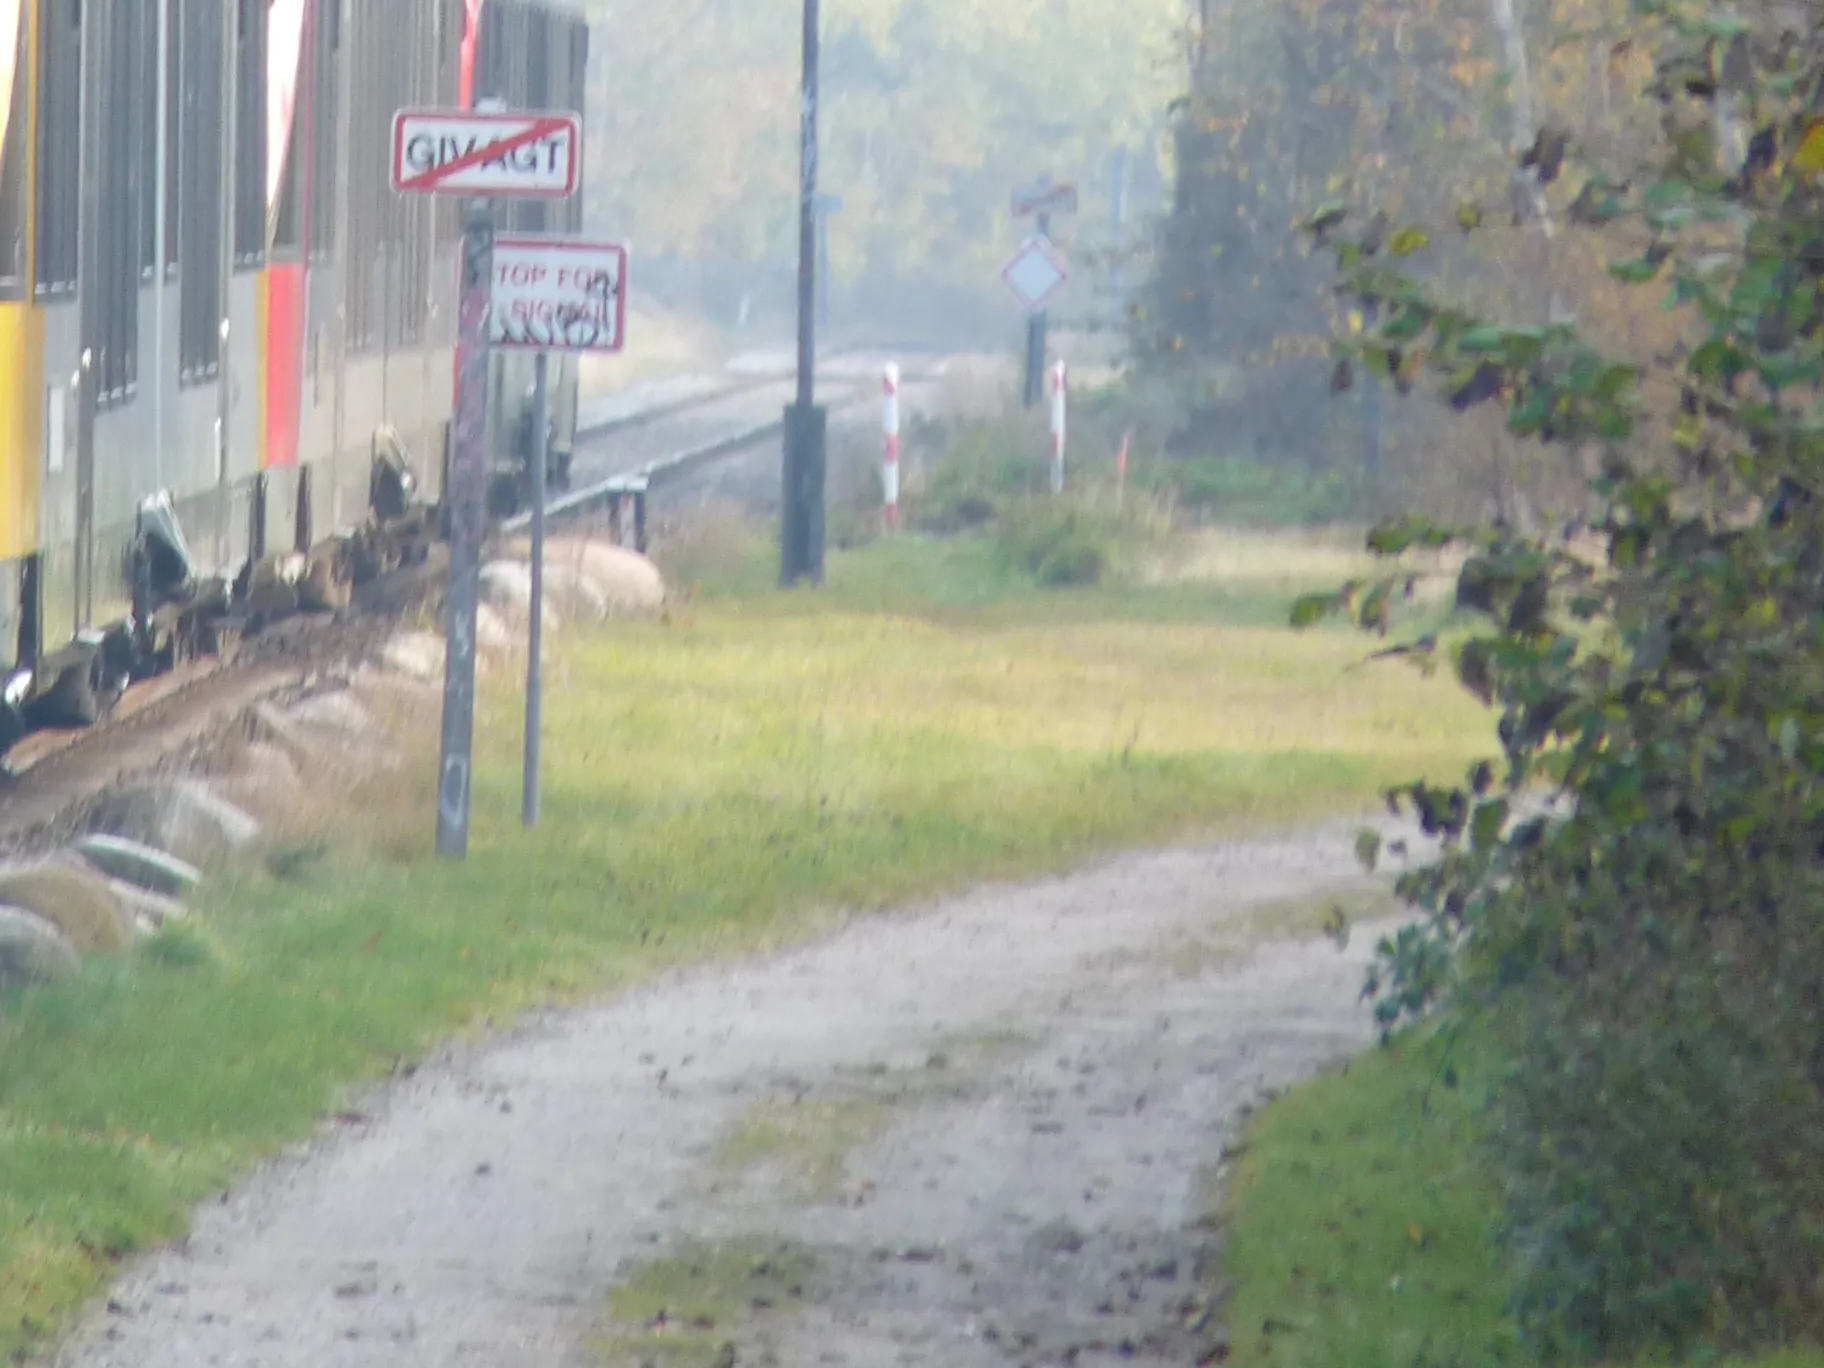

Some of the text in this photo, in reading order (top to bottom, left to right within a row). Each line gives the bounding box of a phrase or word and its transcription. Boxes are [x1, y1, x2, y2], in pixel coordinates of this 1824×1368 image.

[406, 131, 564, 175] GIV AGT
[496, 261, 547, 287] TOP
